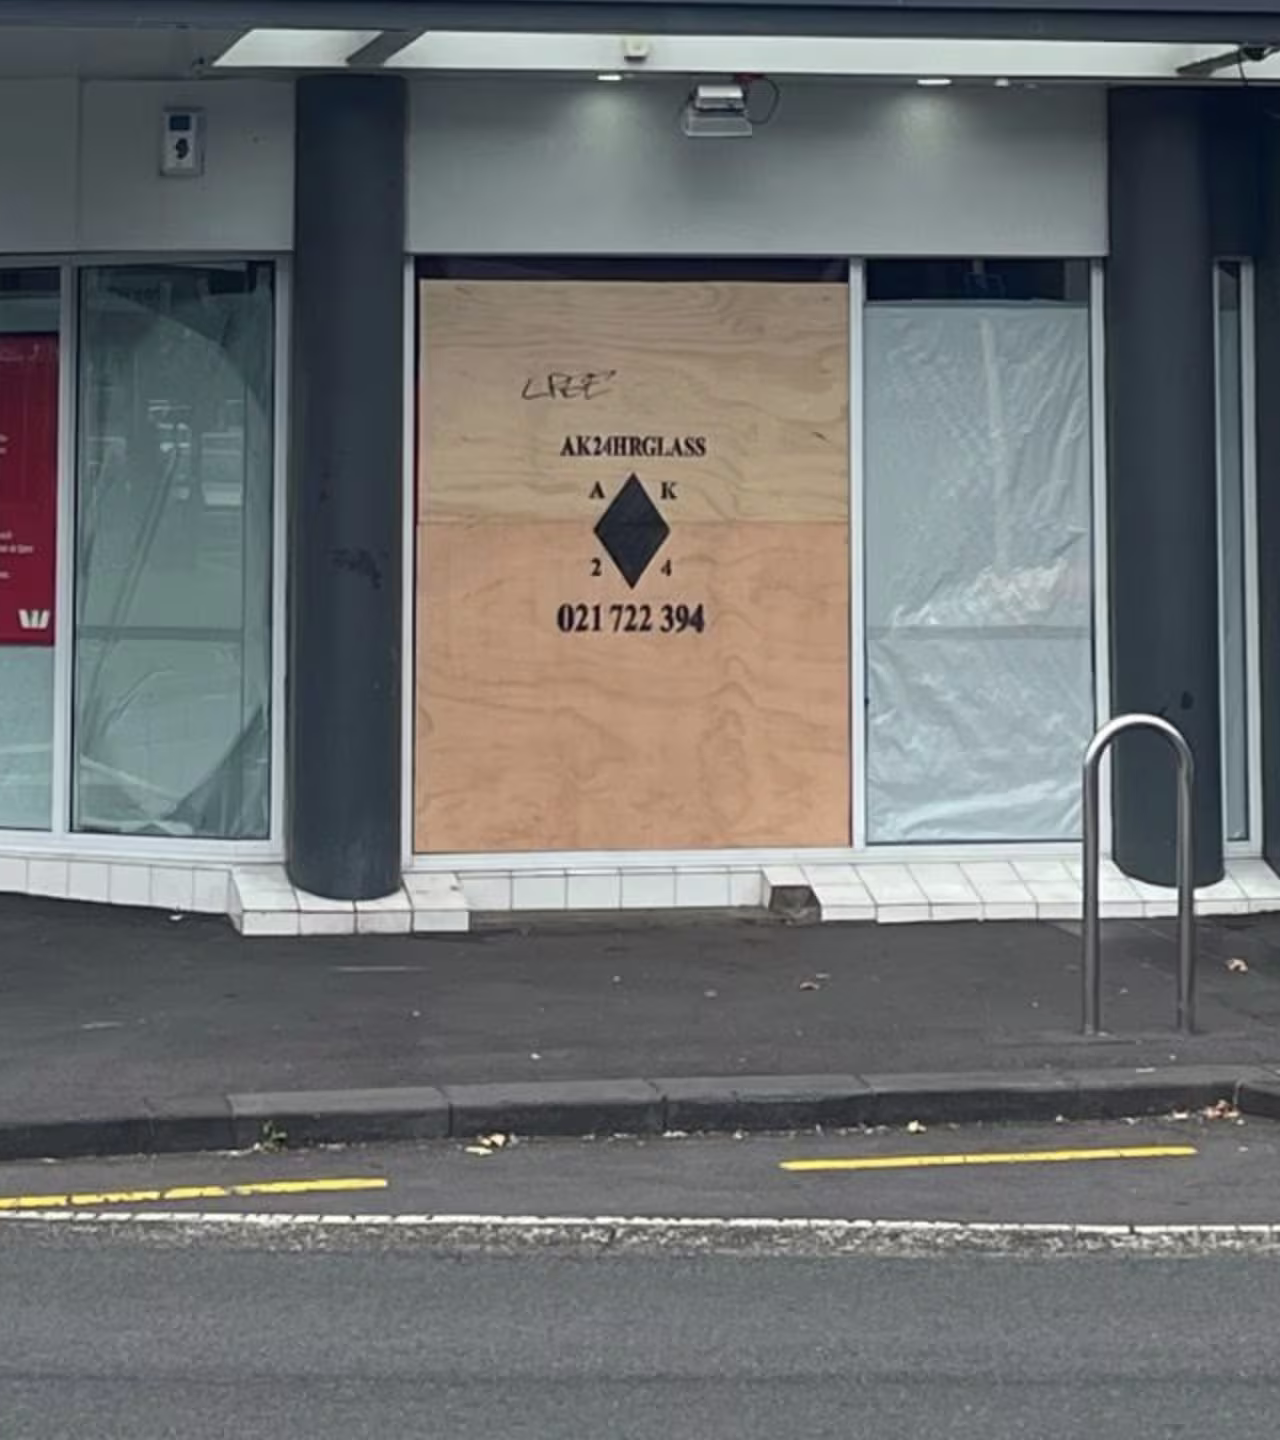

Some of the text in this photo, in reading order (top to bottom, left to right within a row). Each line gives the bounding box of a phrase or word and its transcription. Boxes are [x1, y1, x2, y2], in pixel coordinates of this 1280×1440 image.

[559, 435, 707, 458] AK24HRGLASS
[589, 480, 678, 500] A K
[590, 558, 672, 576] 2 4
[557, 603, 705, 634] 021 722 394
